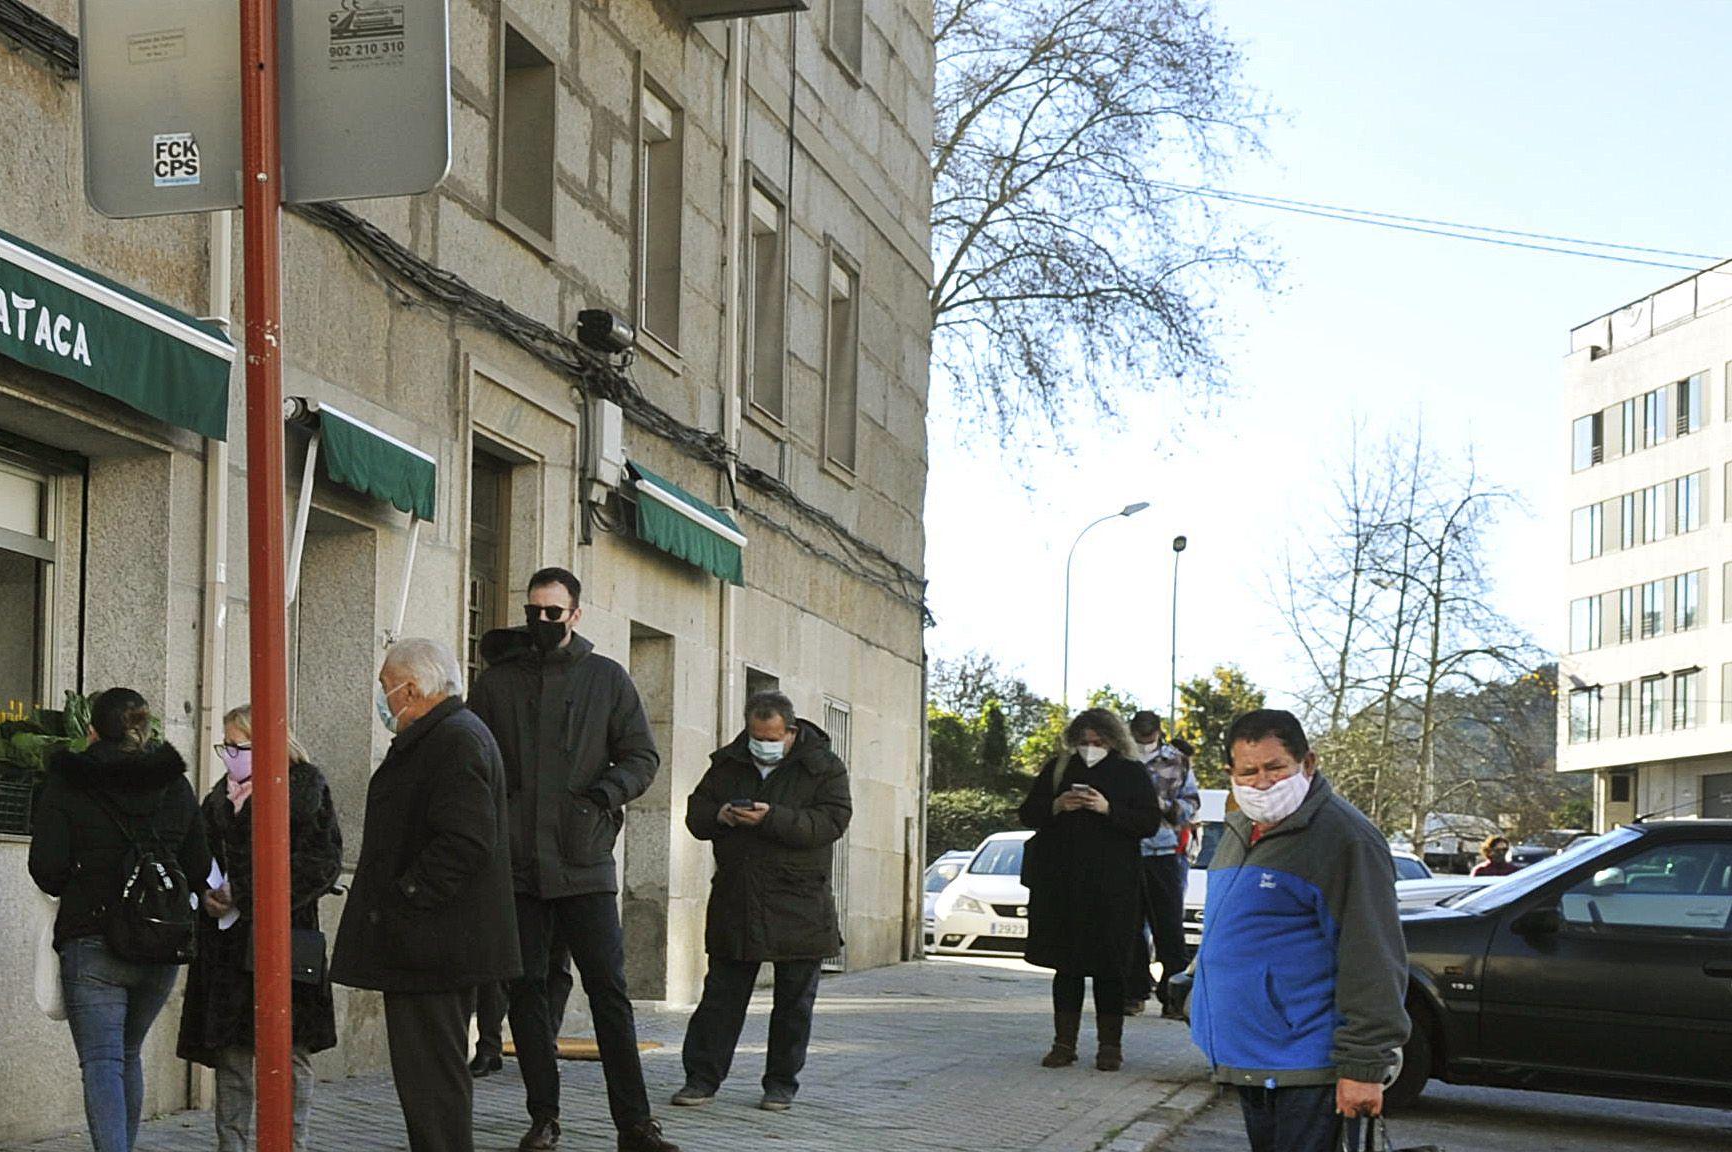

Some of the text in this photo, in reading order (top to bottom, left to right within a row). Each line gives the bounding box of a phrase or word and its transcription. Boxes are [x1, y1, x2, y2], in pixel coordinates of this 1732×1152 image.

[329, 41, 404, 57] 902 210 310
[156, 140, 197, 160] FCK
[155, 159, 198, 178] CPS
[998, 924, 1025, 935] 2923
